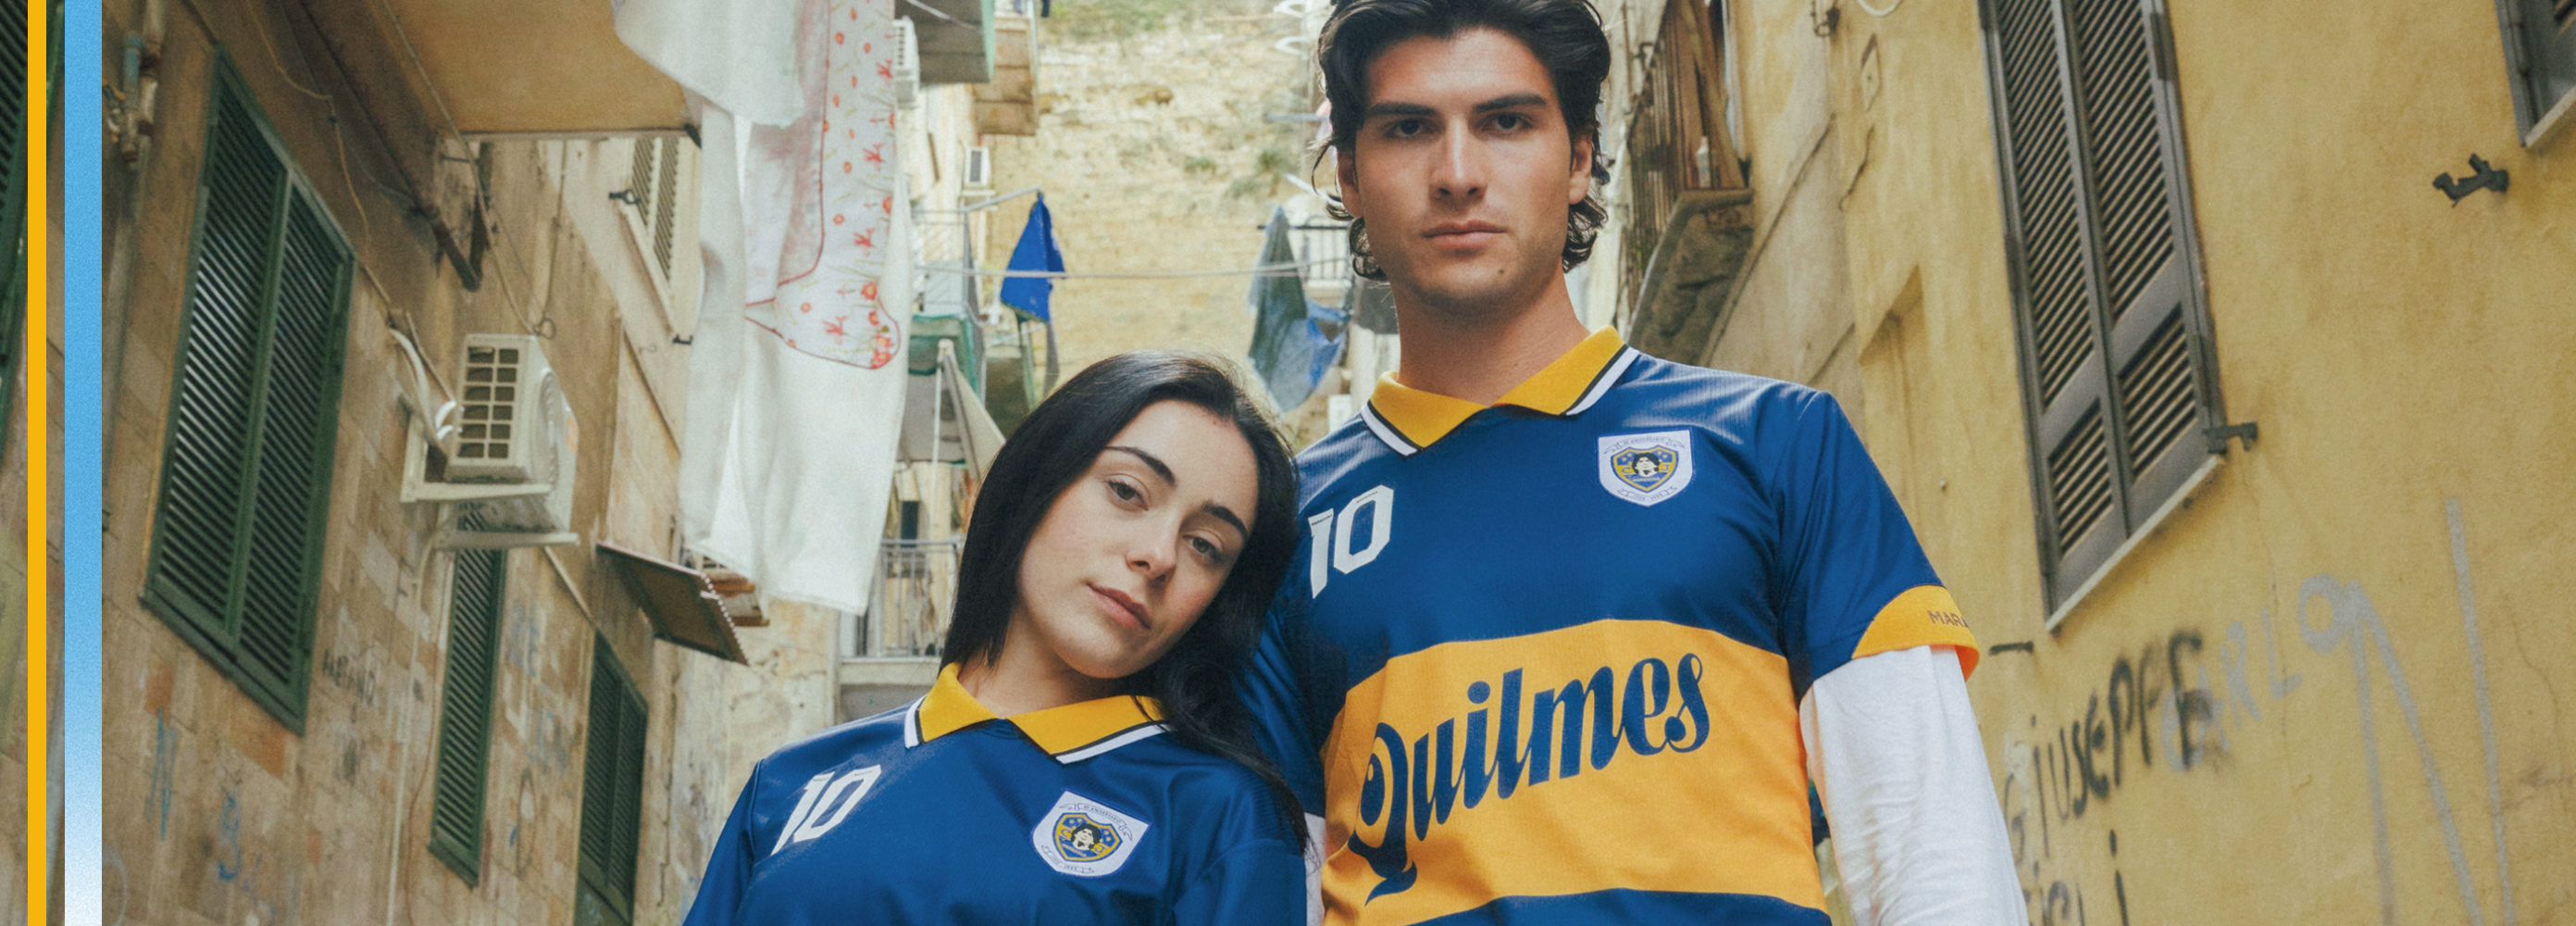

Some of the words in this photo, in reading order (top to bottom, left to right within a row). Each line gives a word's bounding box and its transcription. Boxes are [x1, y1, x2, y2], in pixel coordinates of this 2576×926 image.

[1307, 484, 1394, 599] 10
[770, 764, 881, 857] 10
[1348, 653, 1710, 907] Quilmes
